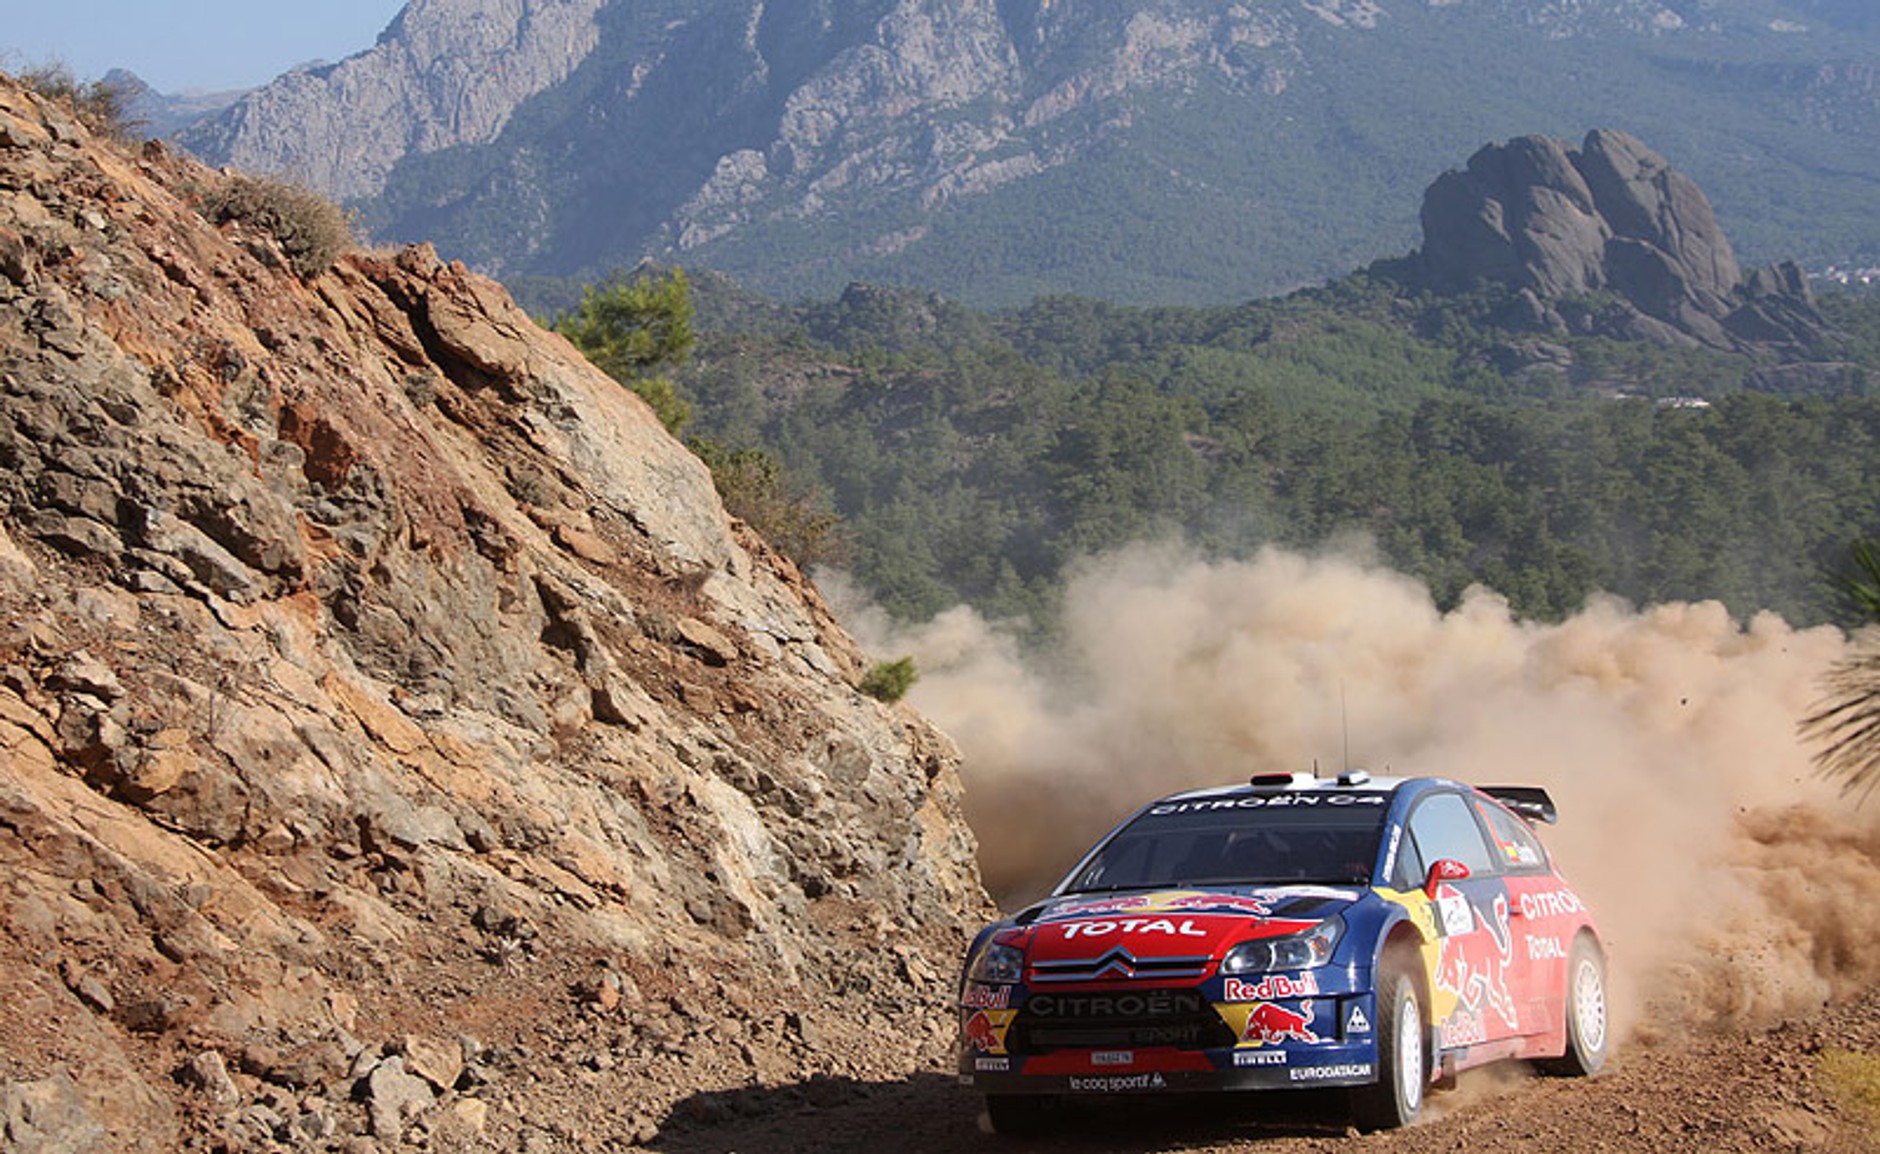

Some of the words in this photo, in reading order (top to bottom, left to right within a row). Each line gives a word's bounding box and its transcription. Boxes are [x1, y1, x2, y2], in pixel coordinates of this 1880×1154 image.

[1327, 794, 1384, 806] C4
[1061, 919, 1207, 940] TOTAL
[1525, 934, 1567, 961] TOTAL
[1224, 975, 1274, 1000] Red
[1274, 971, 1319, 997] Bull
[1029, 990, 1200, 1016] CITROËN
[1289, 1063, 1371, 1081] EURODATACAR
[1082, 1078, 1108, 1092] coq
[1109, 1074, 1149, 1092] sportif
